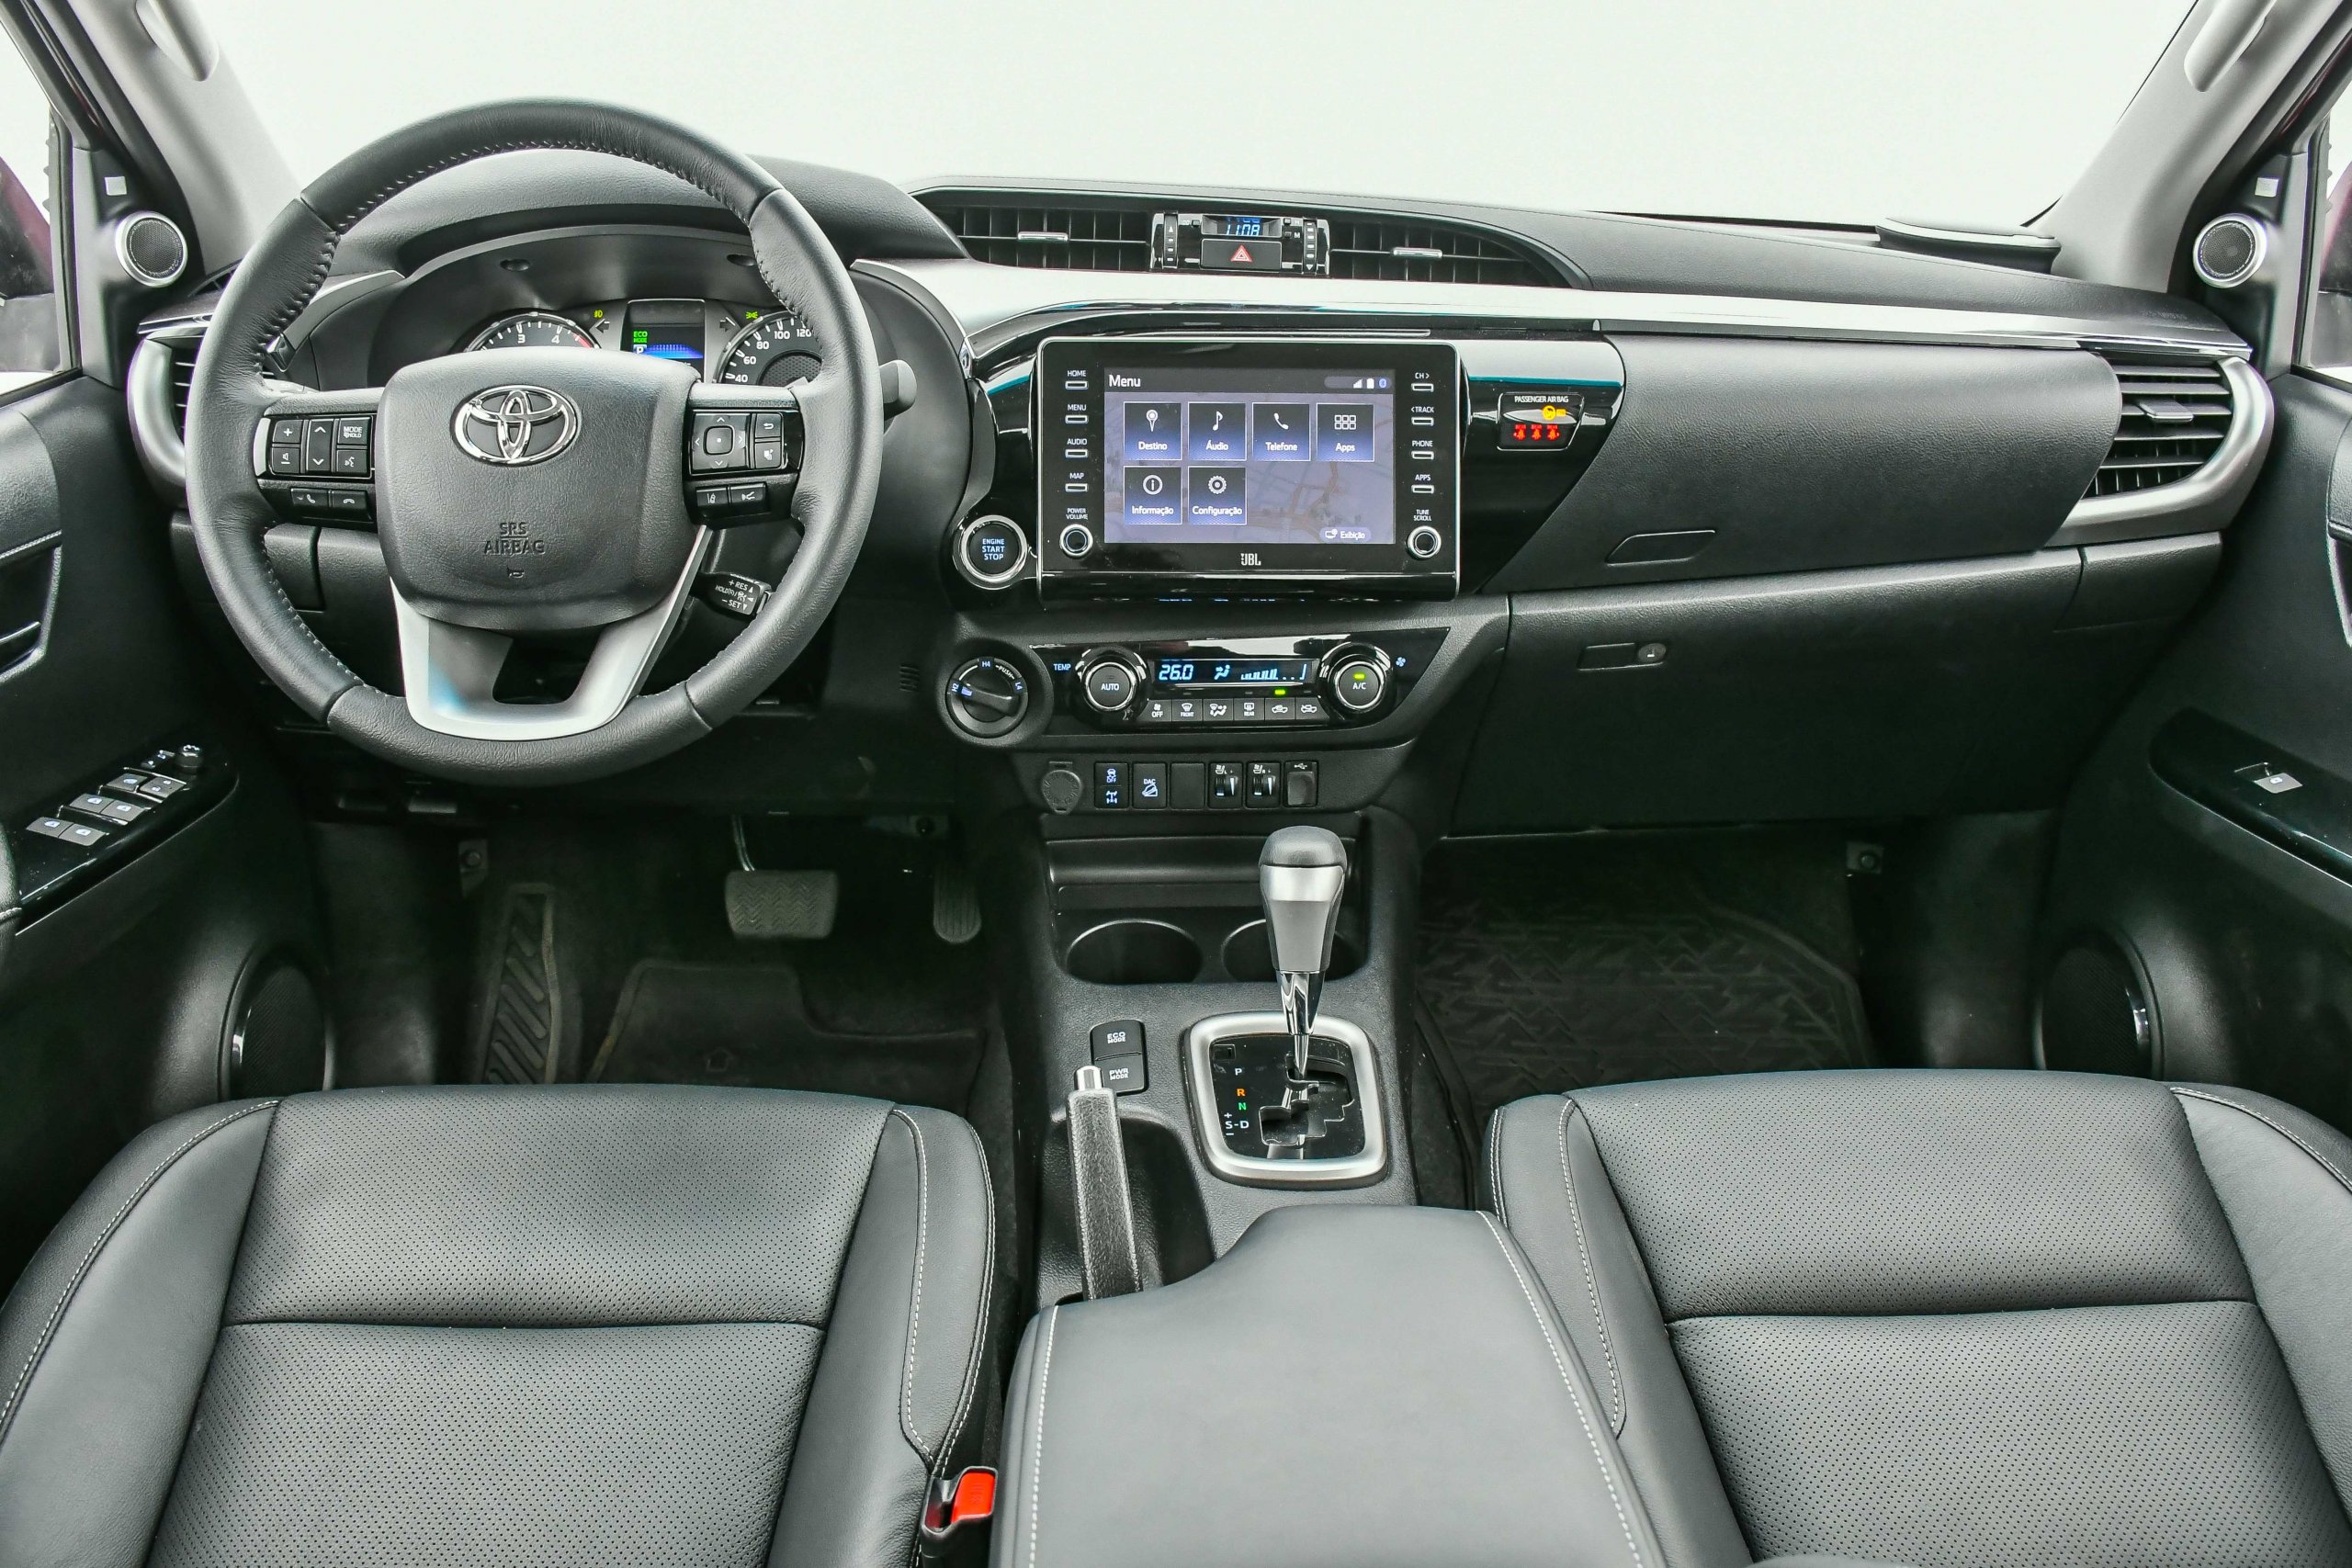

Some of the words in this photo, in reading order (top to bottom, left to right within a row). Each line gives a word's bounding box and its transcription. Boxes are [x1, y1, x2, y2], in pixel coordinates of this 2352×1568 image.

[774, 331, 791, 340] 100
[796, 329, 812, 337] 120
[517, 333, 526, 344] 3
[551, 334, 560, 344] 4
[756, 341, 770, 350] 80
[743, 355, 757, 365] 60
[735, 374, 749, 383] 40
[1108, 374, 1141, 387] Menu
[1514, 395, 1547, 403] PASSENGER
[1138, 441, 1168, 450] Destino
[1205, 439, 1229, 451] Áudio
[1265, 442, 1298, 451] Telefone
[1335, 443, 1356, 453] Apps
[1131, 505, 1174, 516] Informação
[1192, 505, 1243, 517] Configuração
[500, 522, 528, 536] SRS
[483, 539, 546, 556] AIRBAG
[1240, 553, 1261, 566] JBL
[1159, 664, 1194, 681] 26.0
[1107, 1031, 1126, 1040] ECO
[1107, 1036, 1126, 1044] MODE
[1109, 1067, 1129, 1076] PWR
[1234, 1067, 1242, 1076] P
[1110, 1073, 1129, 1081] MODE
[1237, 1089, 1246, 1097] R
[1238, 1102, 1247, 1111] N
